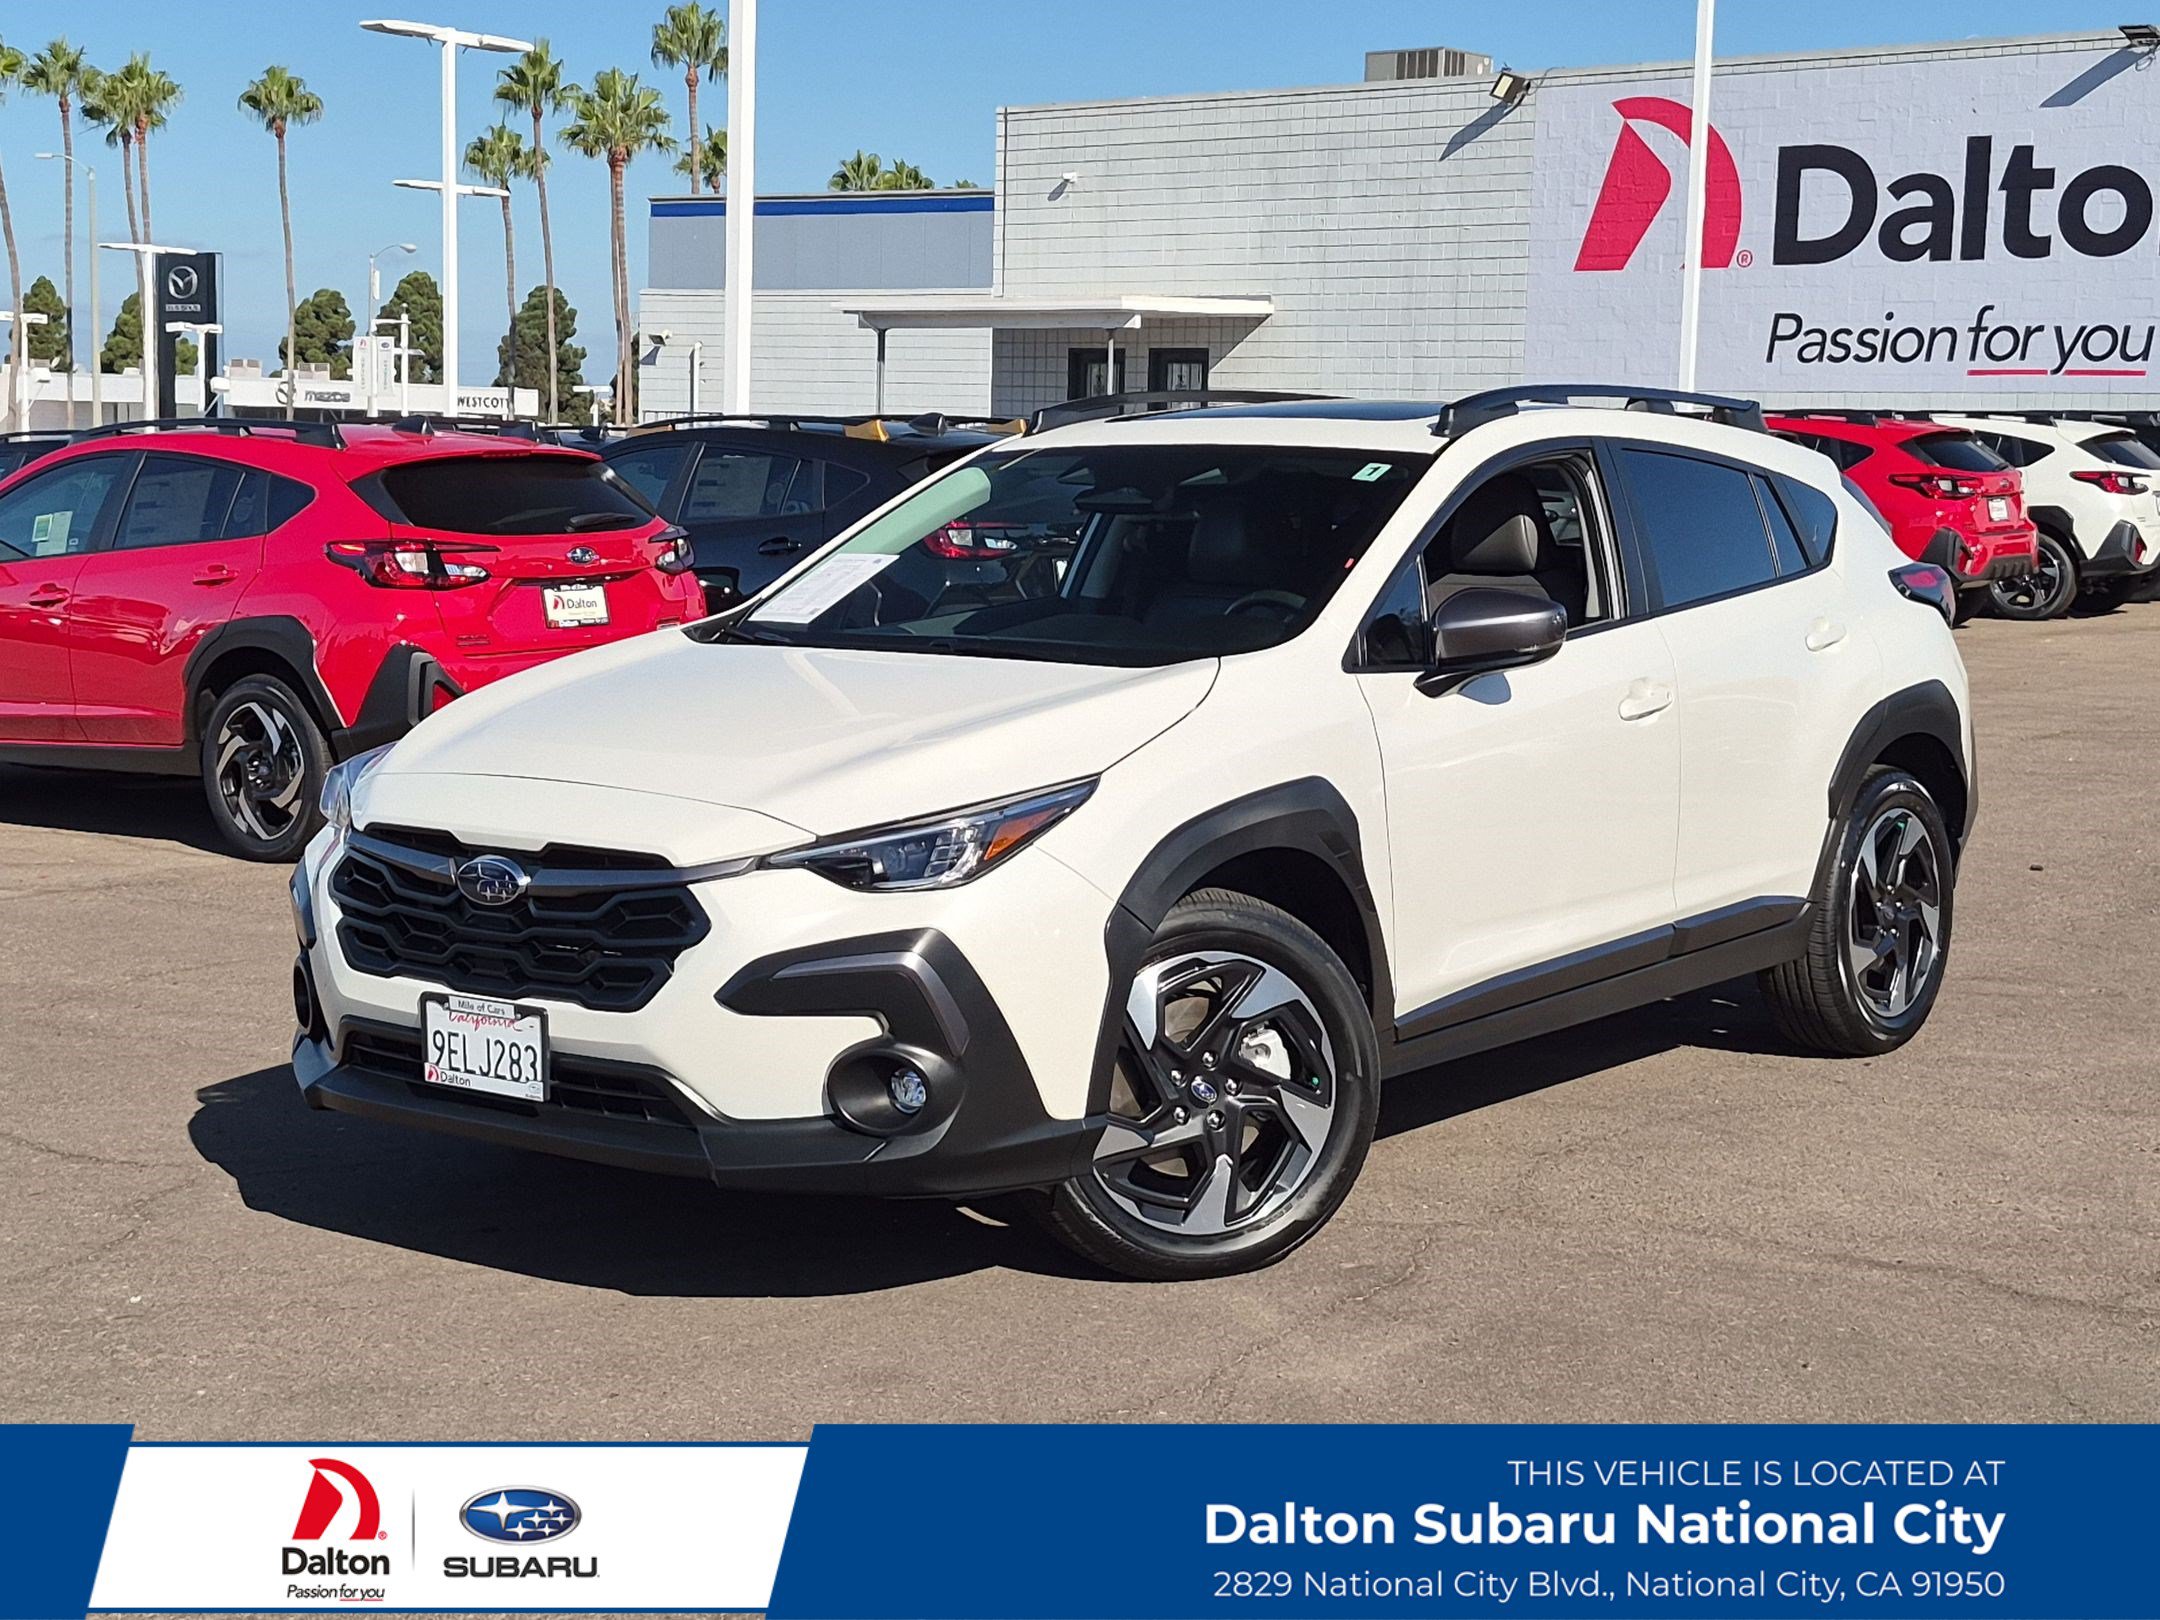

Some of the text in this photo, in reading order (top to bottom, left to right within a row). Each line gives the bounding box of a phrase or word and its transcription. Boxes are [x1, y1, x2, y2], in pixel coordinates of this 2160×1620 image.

[1772, 135, 2160, 266] Dalto
[1766, 304, 2156, 376] Passion for you
[566, 597, 598, 609] Dalton
[457, 1000, 506, 1016] Mile of Cars
[432, 1029, 538, 1083] 9ELJ283
[440, 1071, 471, 1087] Dalton
